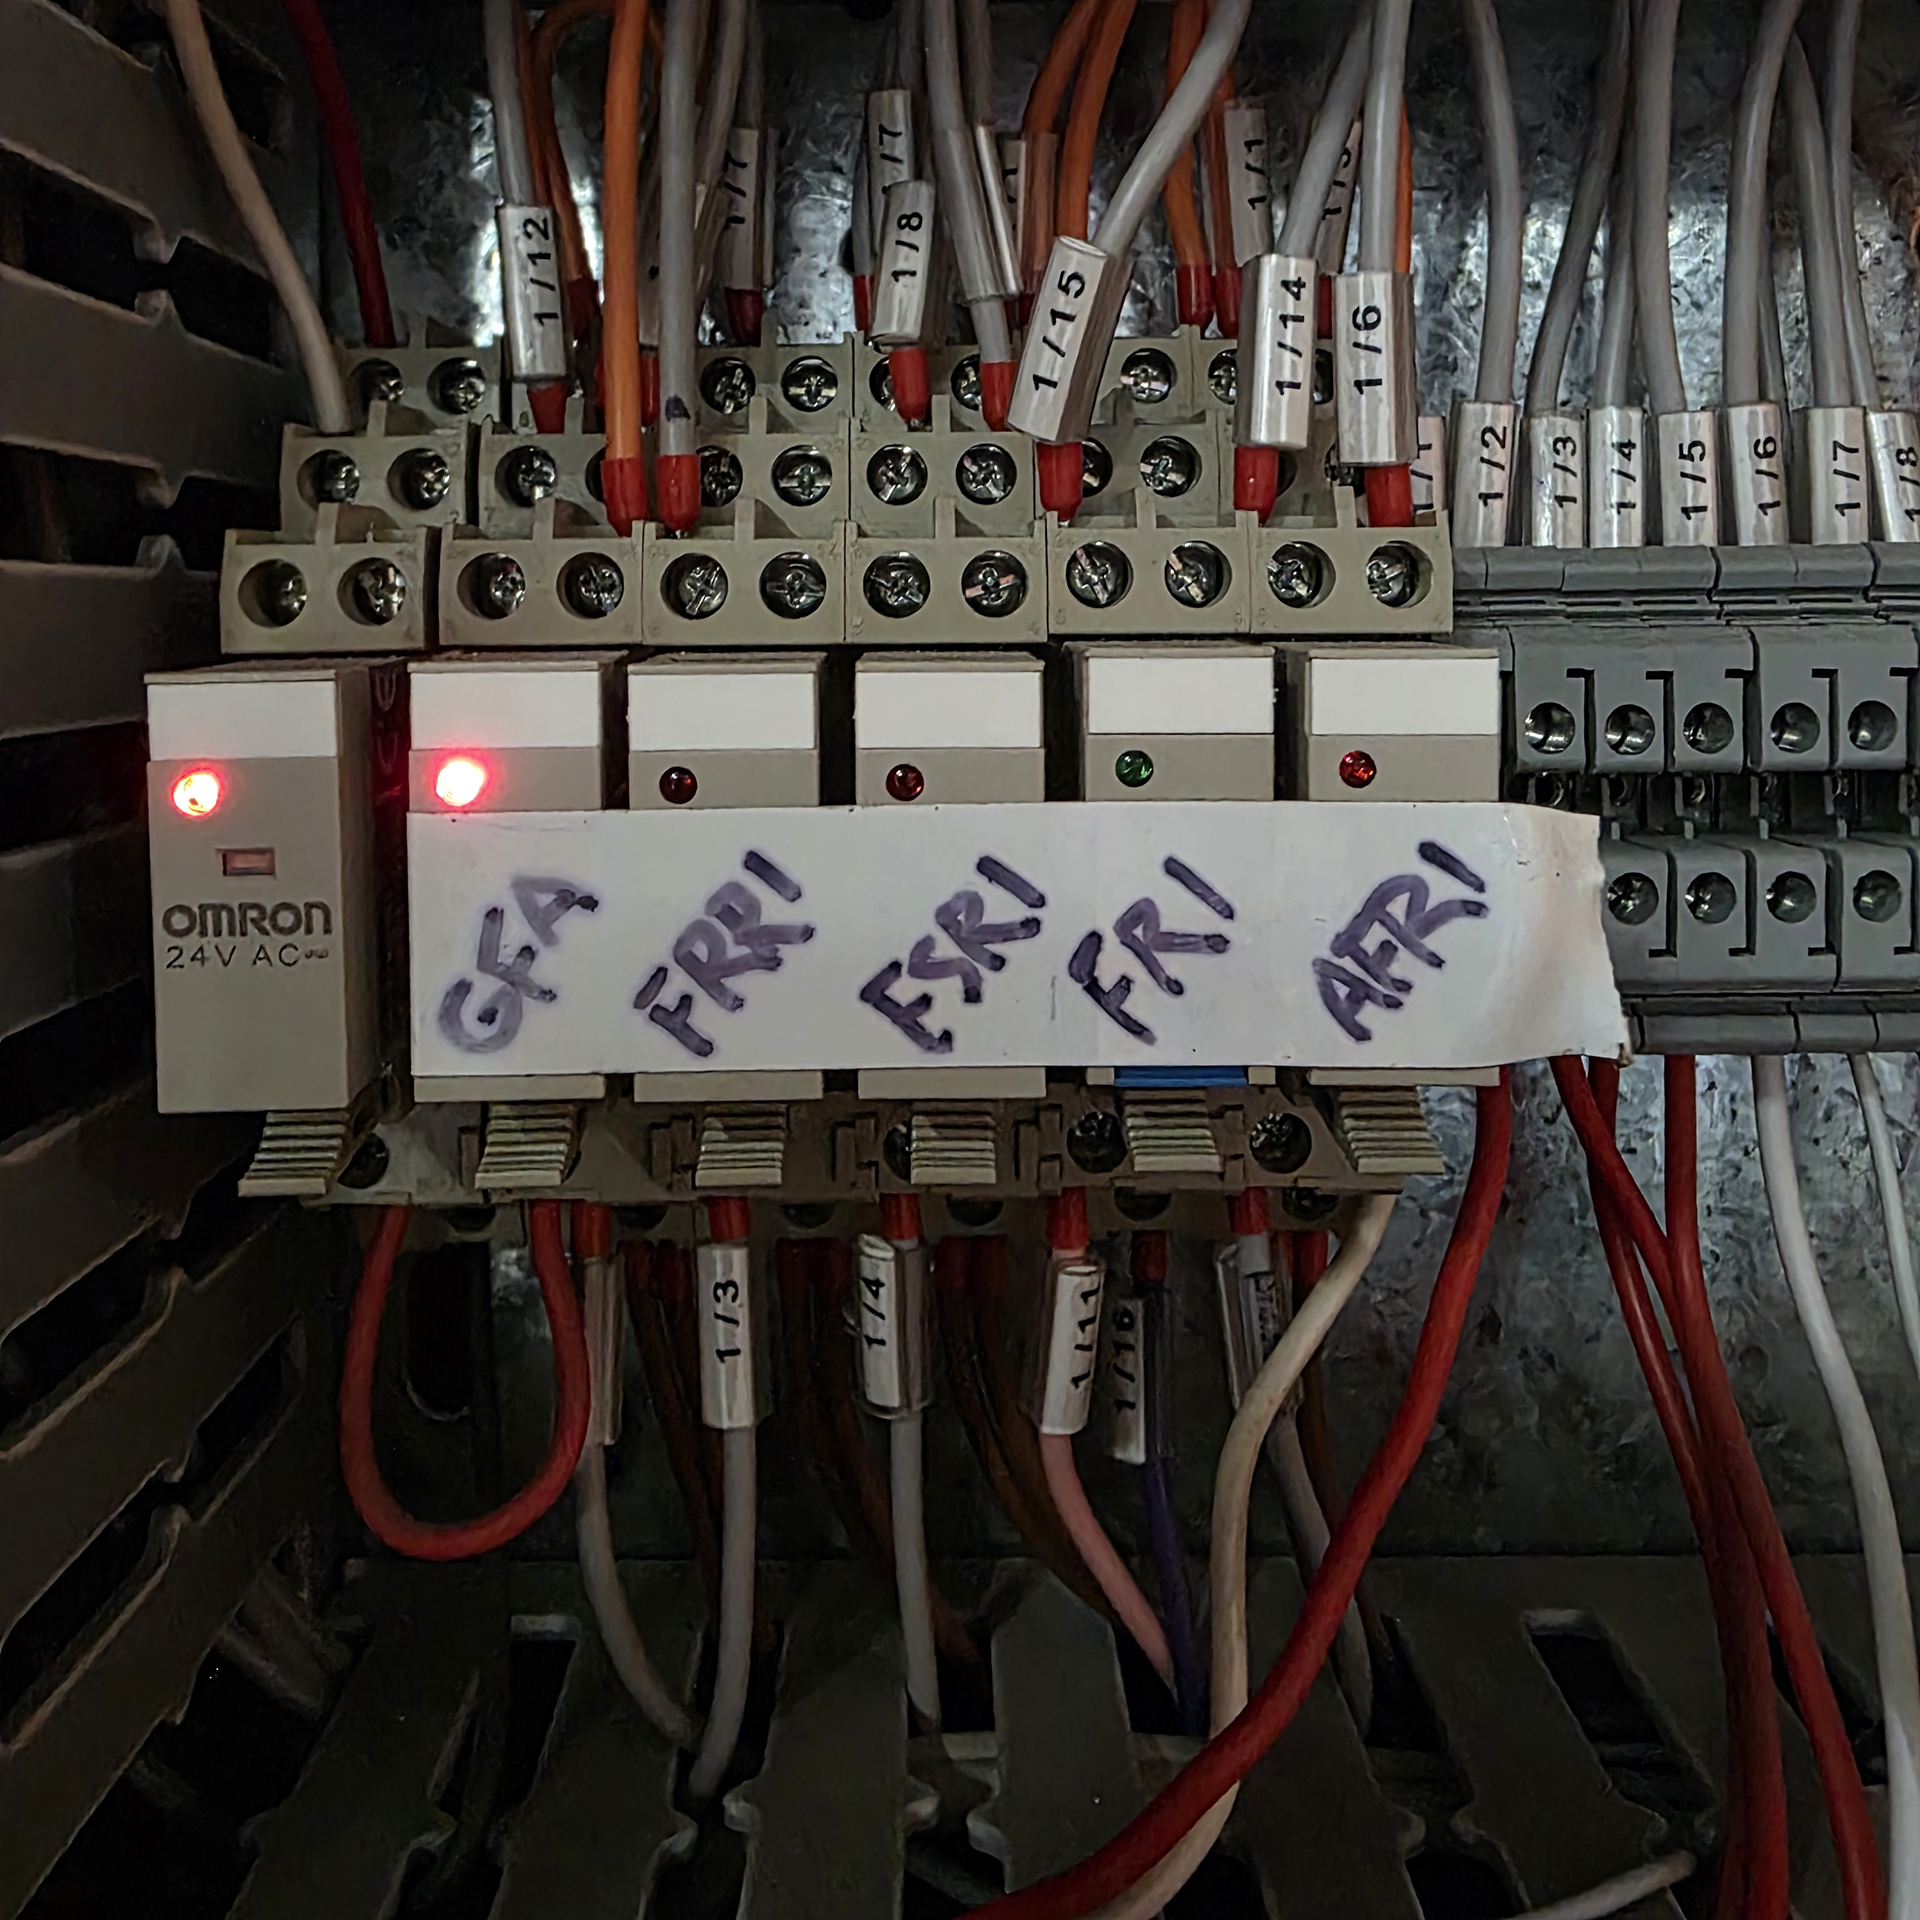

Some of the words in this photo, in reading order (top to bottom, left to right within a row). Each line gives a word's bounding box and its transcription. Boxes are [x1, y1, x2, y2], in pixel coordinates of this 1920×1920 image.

[523, 215, 559, 327] 1/12
[891, 210, 924, 282] 1/8
[1032, 269, 1086, 392] 1/15
[1275, 276, 1307, 396] 1/14
[1352, 304, 1383, 396] 1/6
[1477, 424, 1508, 508] 1/2
[1552, 435, 1578, 509] 1/3
[1611, 437, 1637, 515] 1/4
[1678, 439, 1708, 522] 1/5
[1753, 435, 1781, 517] 1/6
[1832, 439, 1861, 518] 1/7
[162, 901, 332, 938] OMRON
[165, 944, 237, 969] 24V
[712, 1278, 741, 1364] 1/3
[860, 1275, 886, 1350] 1/4
[1071, 1285, 1100, 1390] 1/11
